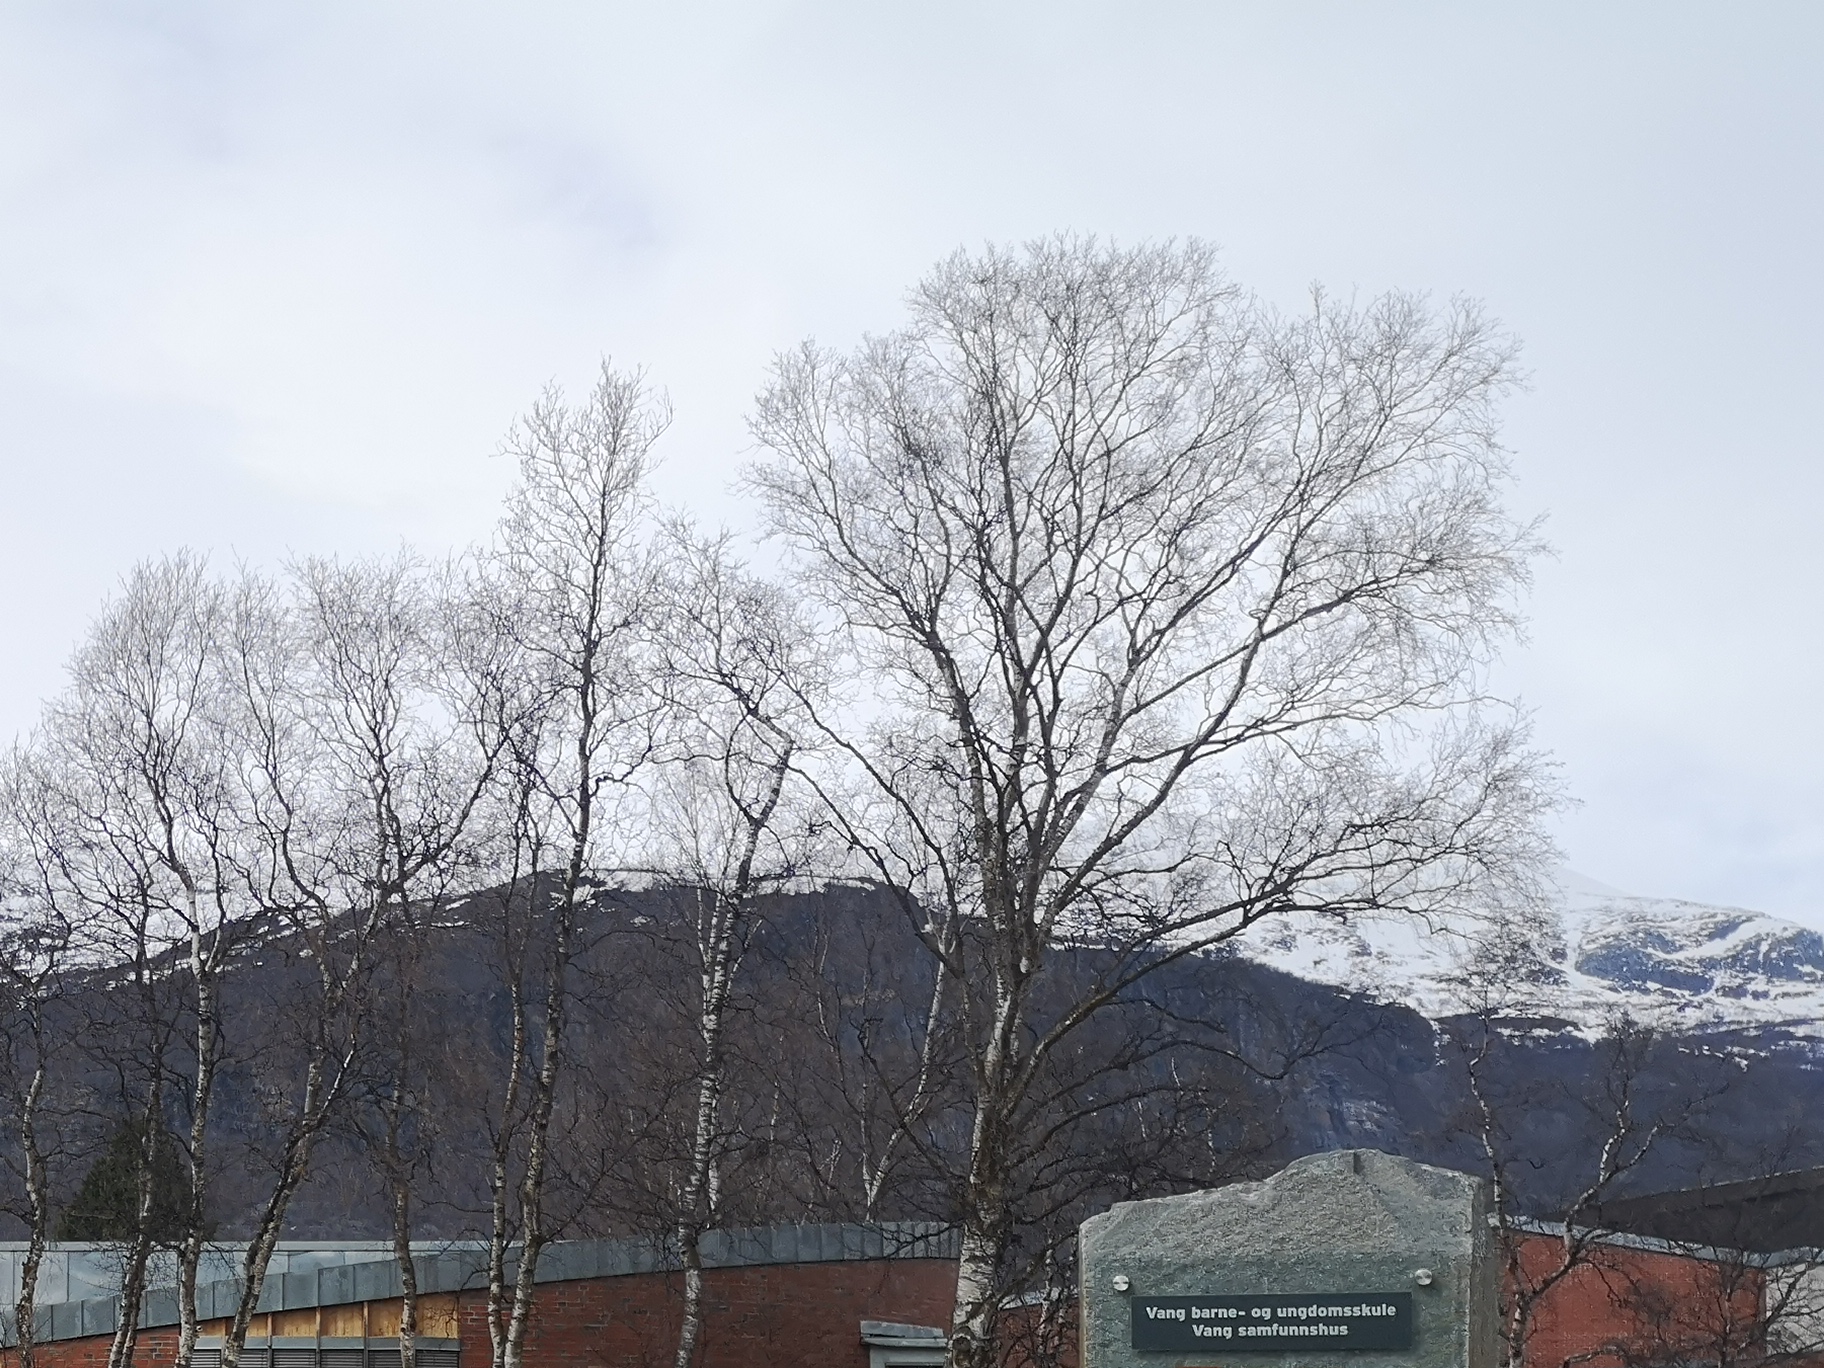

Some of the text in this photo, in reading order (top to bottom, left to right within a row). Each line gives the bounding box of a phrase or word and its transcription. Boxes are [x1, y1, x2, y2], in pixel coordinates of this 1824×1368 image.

[1146, 1304, 1396, 1321] Vang barne- og ungdomsskule
[1192, 1323, 1348, 1339] Vang samfunnshus
